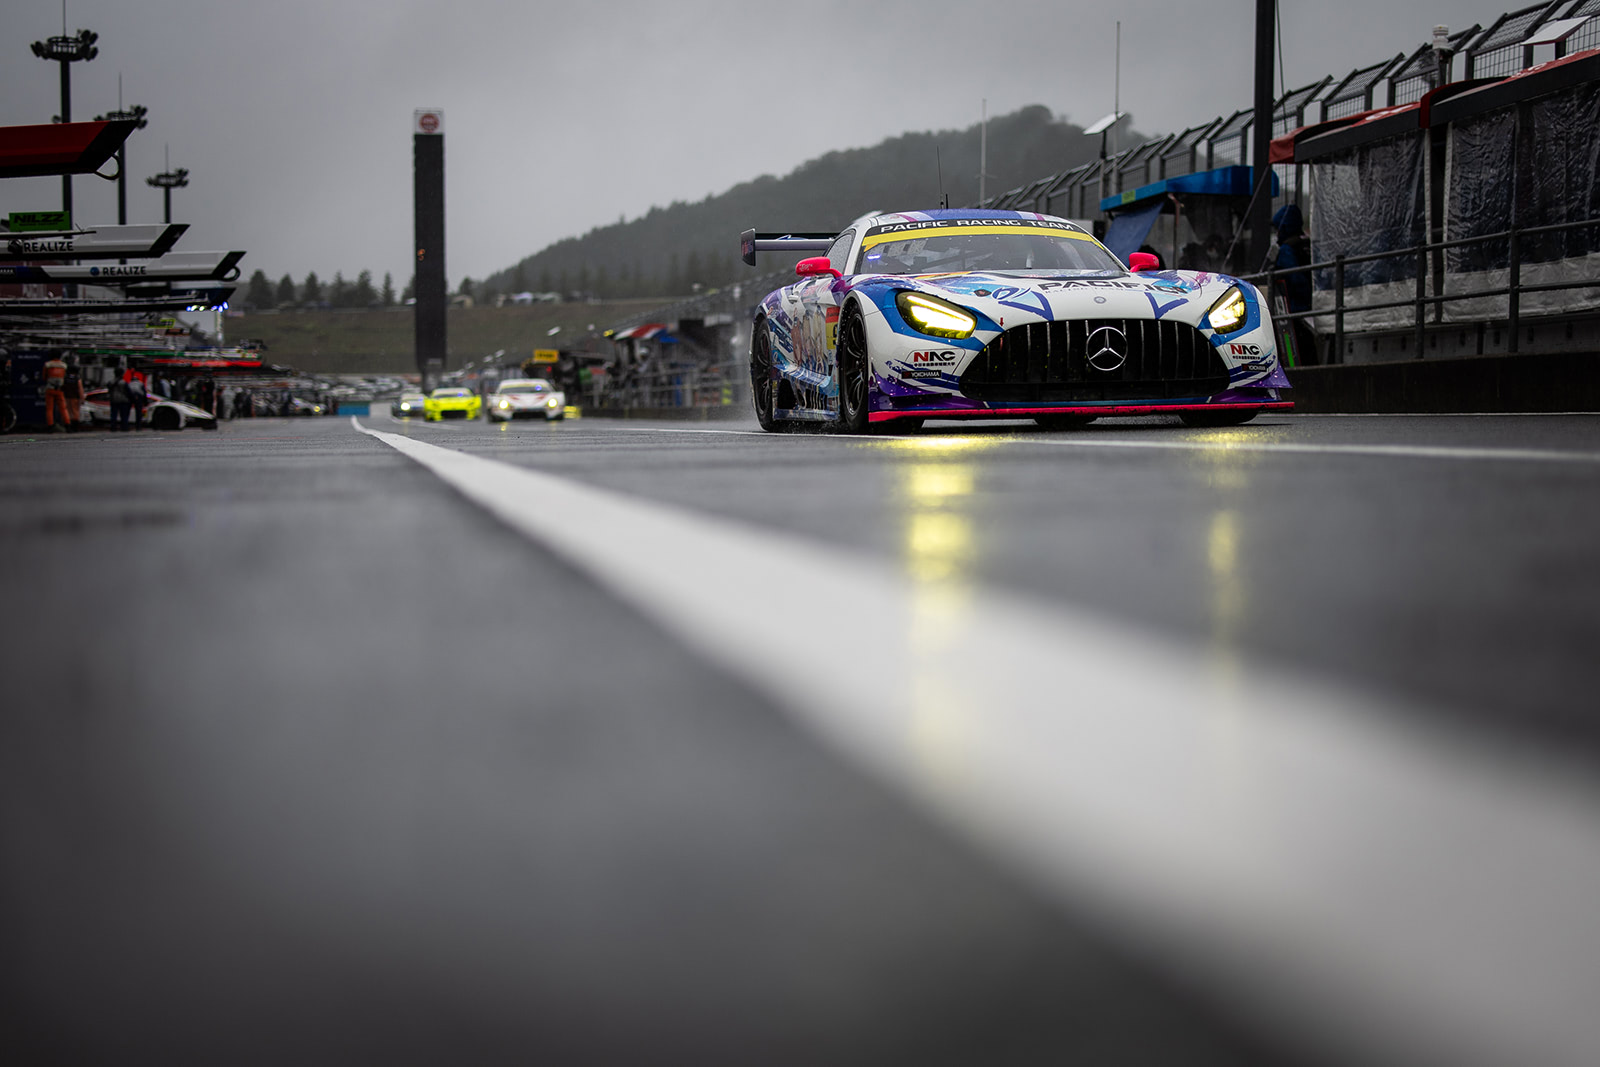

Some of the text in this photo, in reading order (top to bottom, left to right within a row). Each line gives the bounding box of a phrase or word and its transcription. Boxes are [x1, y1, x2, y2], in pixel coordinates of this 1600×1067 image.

[14, 214, 64, 223] NILZZ
[880, 220, 948, 233] PACIFIC
[1027, 220, 1074, 230] TEAM
[24, 241, 73, 252] REALIZE
[102, 266, 146, 276] REALIZE
[1038, 280, 1183, 294] PACIFIC
[1230, 344, 1260, 355] NAC
[914, 351, 956, 362] NAC
